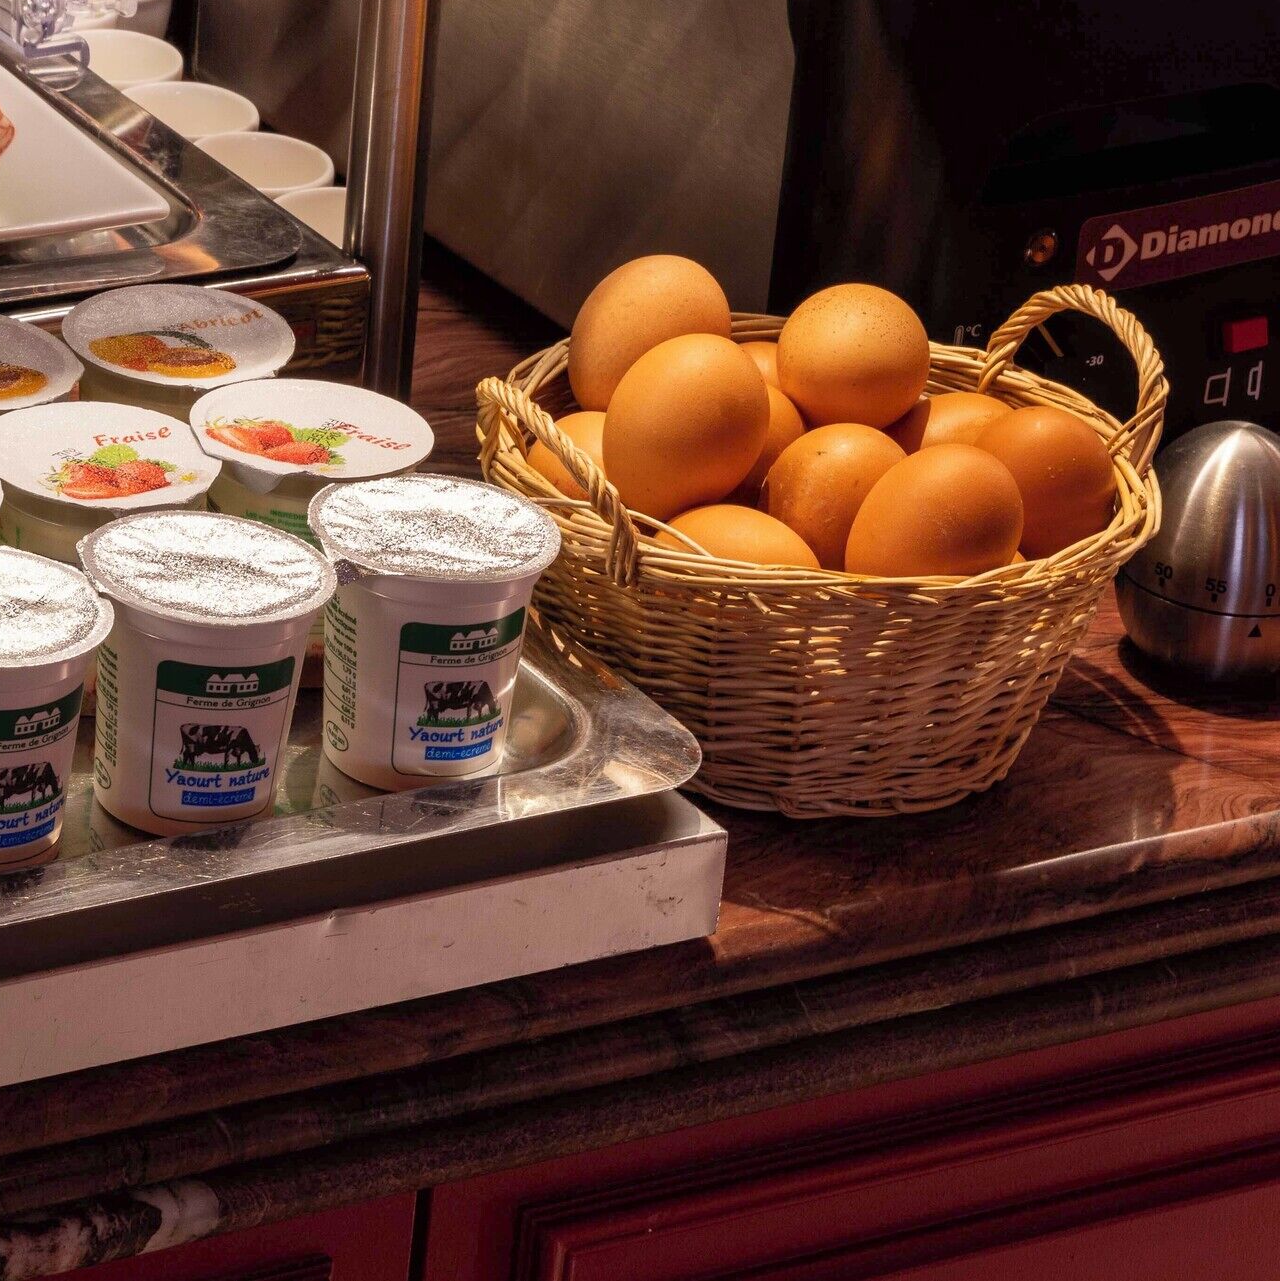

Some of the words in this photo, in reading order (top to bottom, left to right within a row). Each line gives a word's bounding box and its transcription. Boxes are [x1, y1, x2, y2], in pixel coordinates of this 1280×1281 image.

[93, 425, 172, 447] Fraise
[335, 421, 412, 451] Fraise
[430, 654, 462, 664] Ferme
[464, 654, 476, 664] de
[186, 696, 219, 708] Ferme
[222, 699, 234, 708] de
[408, 725, 465, 742] Yaourt
[470, 716, 505, 741] nature
[28, 738, 40, 748] de
[165, 768, 222, 788] Yaourt
[229, 767, 270, 787] nature
